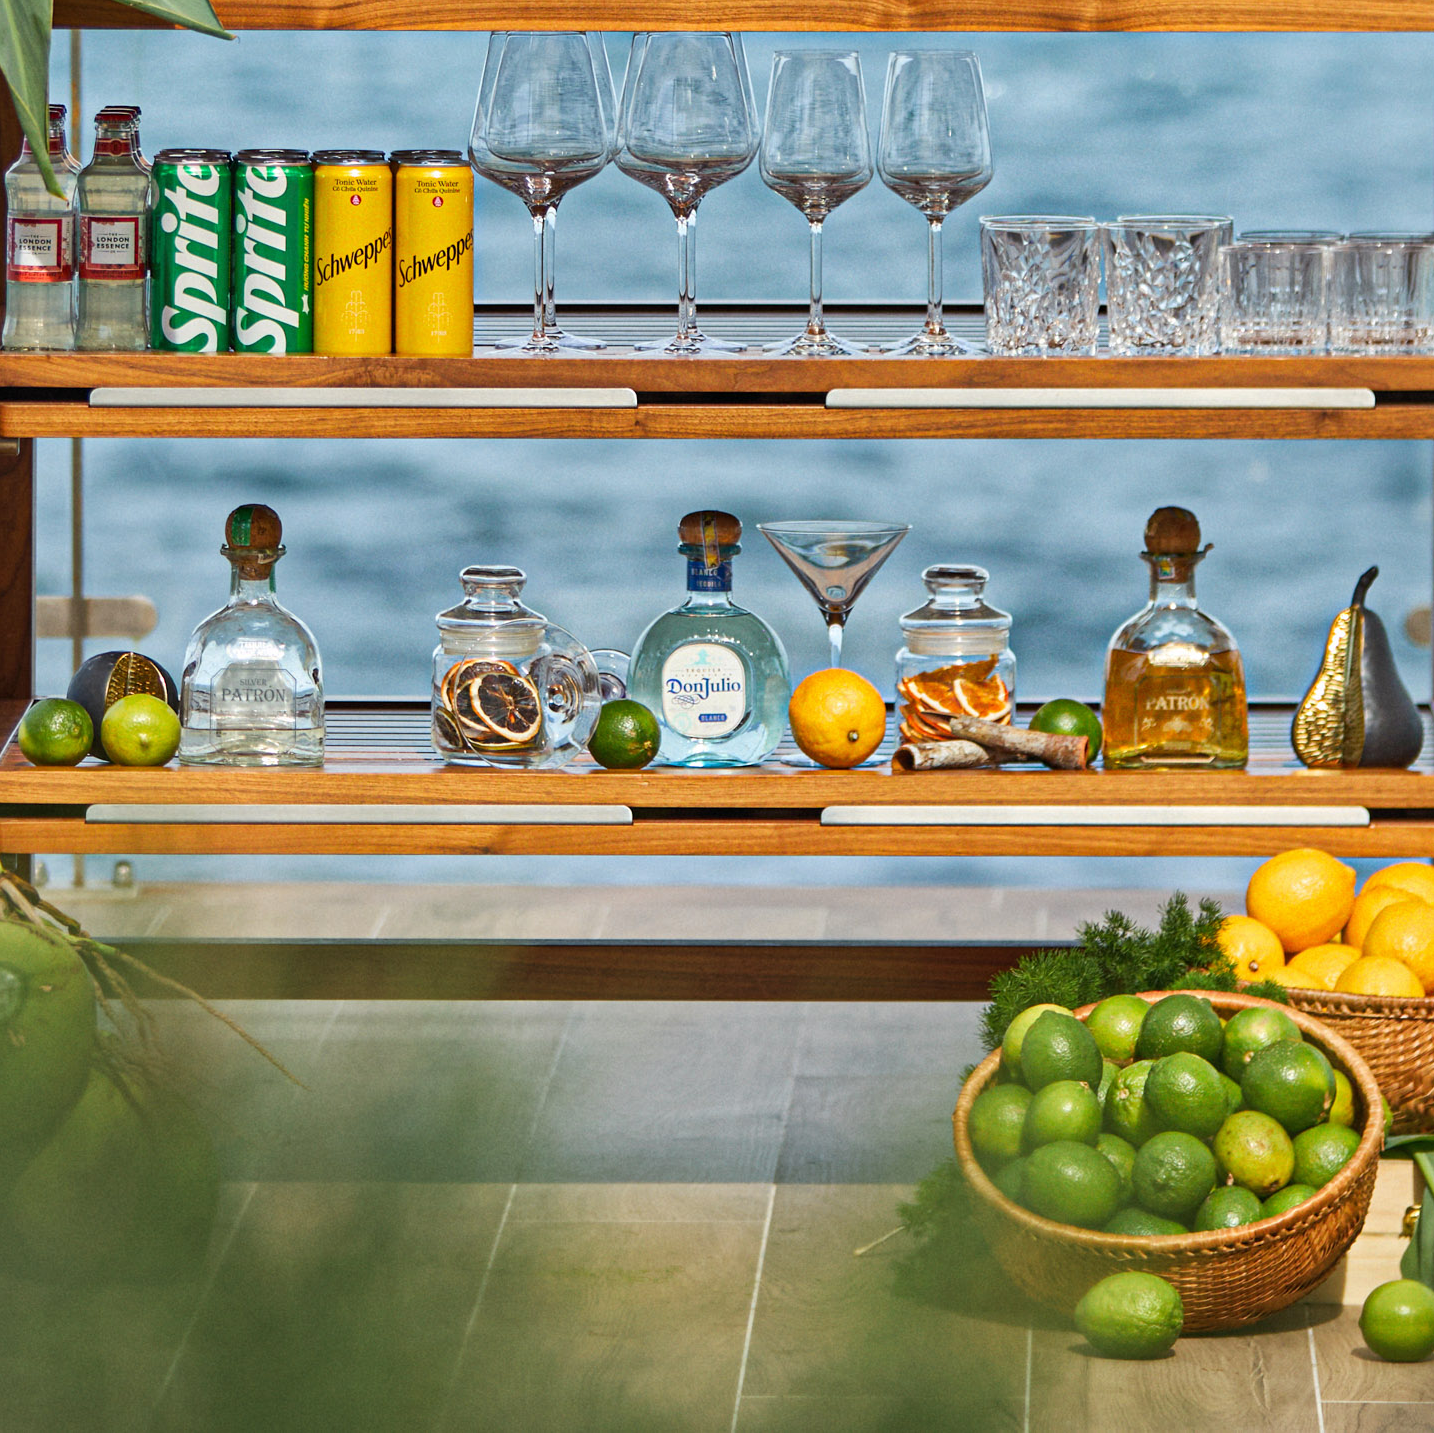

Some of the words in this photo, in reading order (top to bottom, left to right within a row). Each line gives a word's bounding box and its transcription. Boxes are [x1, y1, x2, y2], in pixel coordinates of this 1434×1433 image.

[161, 165, 227, 353] Sprite
[236, 165, 299, 354] Sprite
[222, 685, 286, 702] PATRÓN
